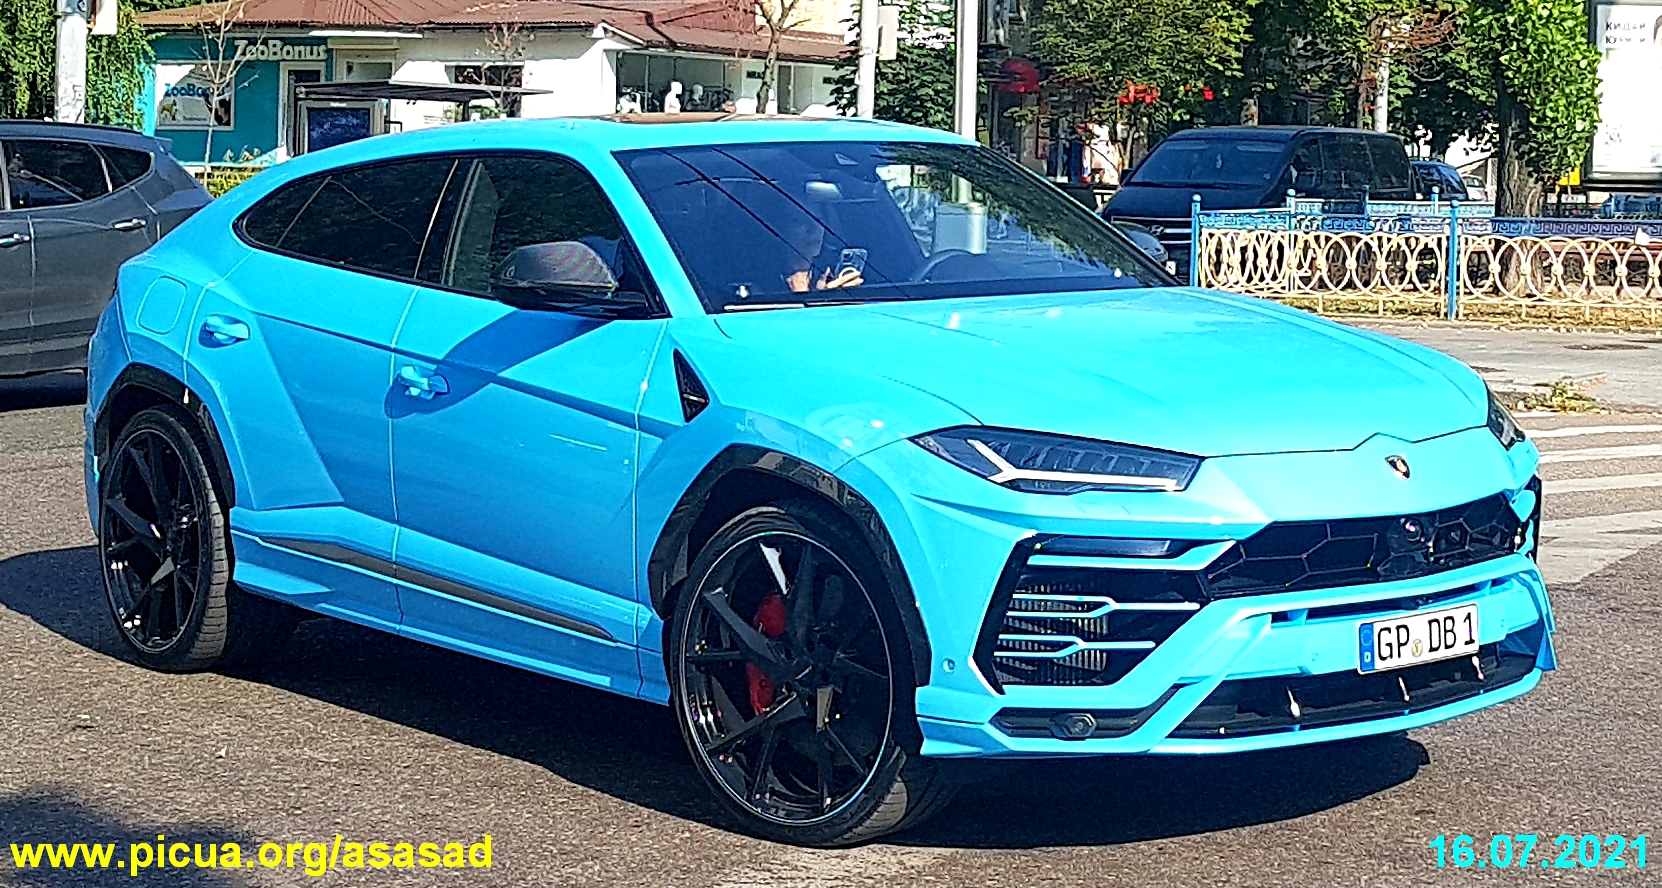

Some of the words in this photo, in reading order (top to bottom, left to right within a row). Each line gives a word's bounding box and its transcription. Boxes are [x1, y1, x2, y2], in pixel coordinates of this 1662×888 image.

[234, 39, 327, 60] ZooBonus
[1377, 624, 1410, 661] GP
[1428, 616, 1457, 653] DB
[1463, 612, 1476, 646] 1
